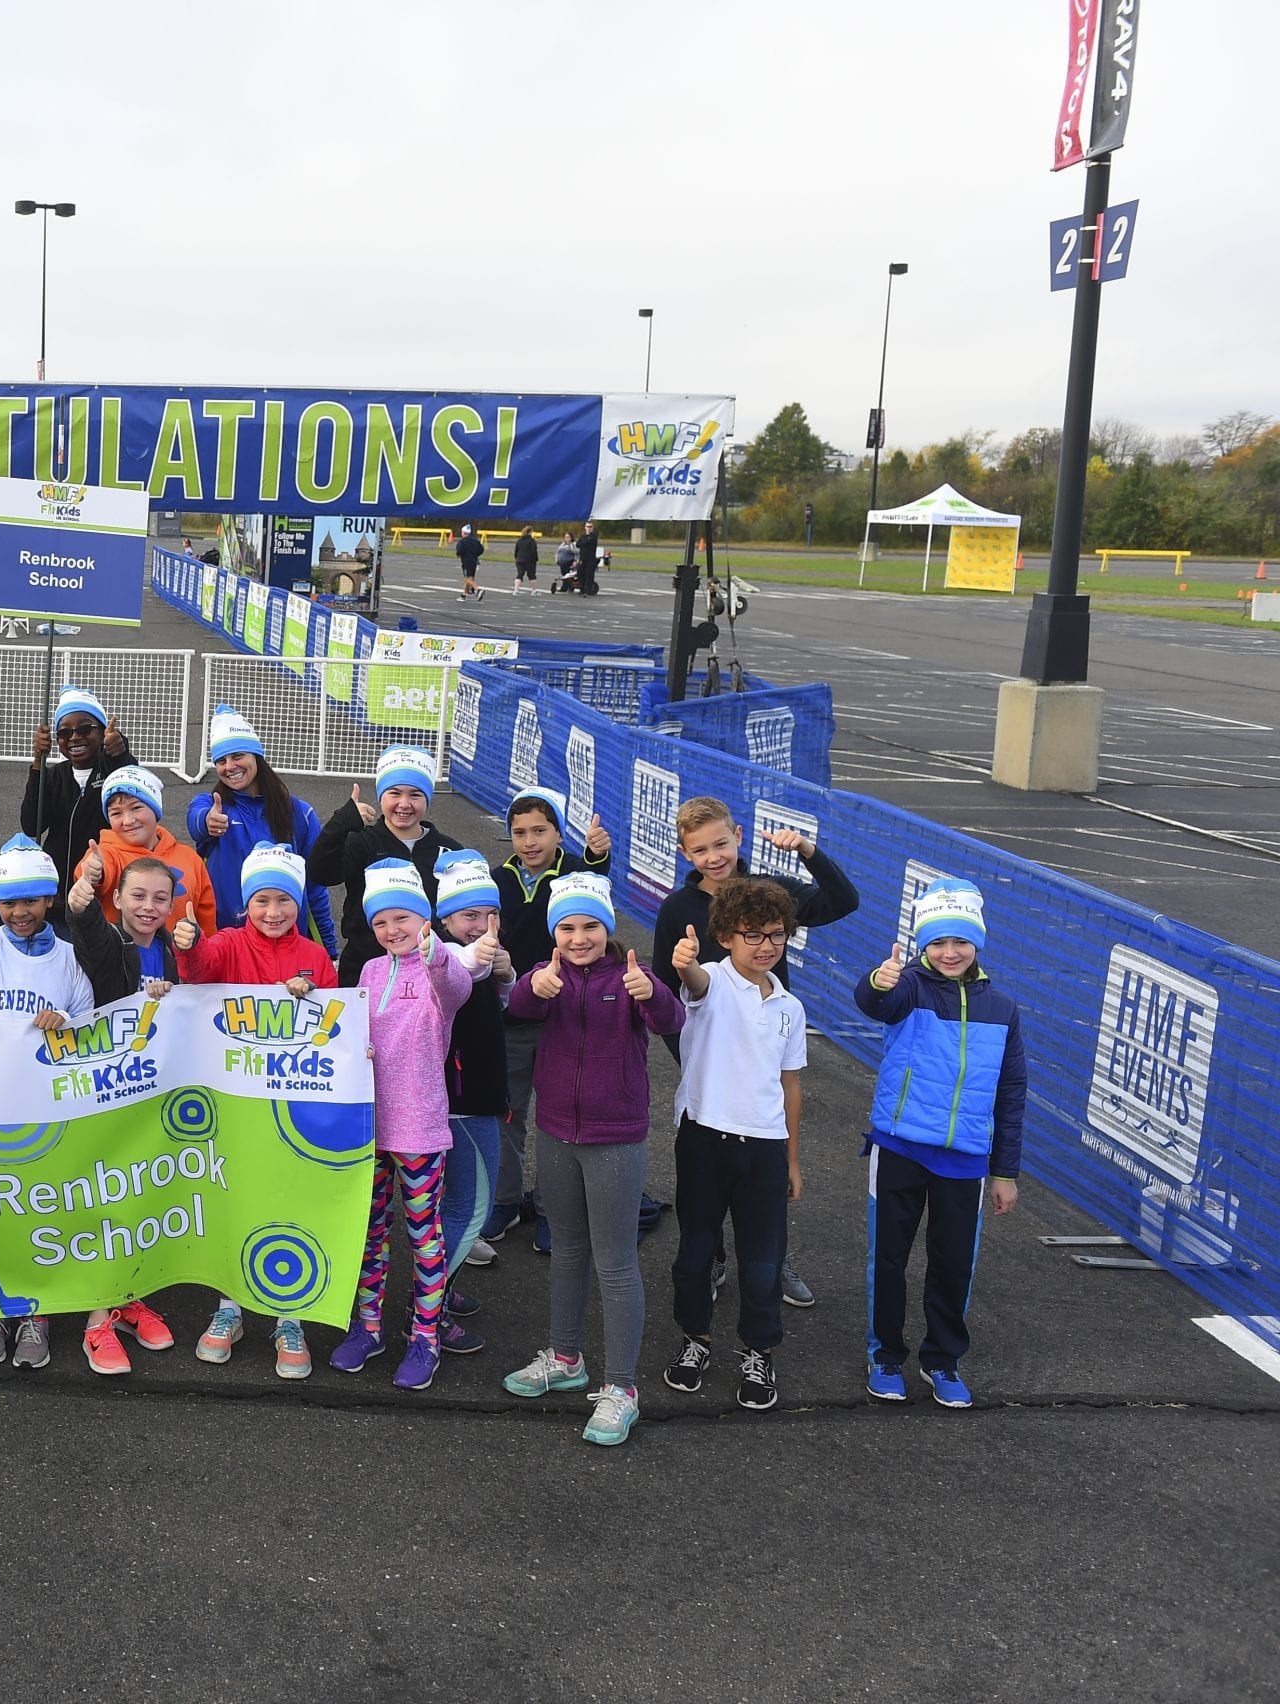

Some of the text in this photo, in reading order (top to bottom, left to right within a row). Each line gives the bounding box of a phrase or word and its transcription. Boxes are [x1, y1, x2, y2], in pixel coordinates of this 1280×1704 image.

[1055, 228, 1078, 275] 2
[1107, 216, 1129, 264] 2
[618, 419, 721, 461] HMF!
[40, 484, 88, 506] HMF!
[342, 517, 377, 534] RUN
[19, 550, 96, 571] Renbrook
[28, 571, 84, 590] School
[421, 637, 456, 653] HMF!
[474, 641, 511, 656] HMF!
[639, 773, 675, 824] HMF
[256, 849, 293, 861] aetna
[637, 815, 672, 858] EVENTS
[42, 1000, 161, 1065] HMF!
[223, 995, 346, 1047] HMF!
[1116, 970, 1205, 1069] HMF
[1108, 1037, 1194, 1126] EVENTS
[1081, 1130, 1193, 1214] HARTFORD MARATHON FOUNDATION
[29, 1193, 206, 1268] School
